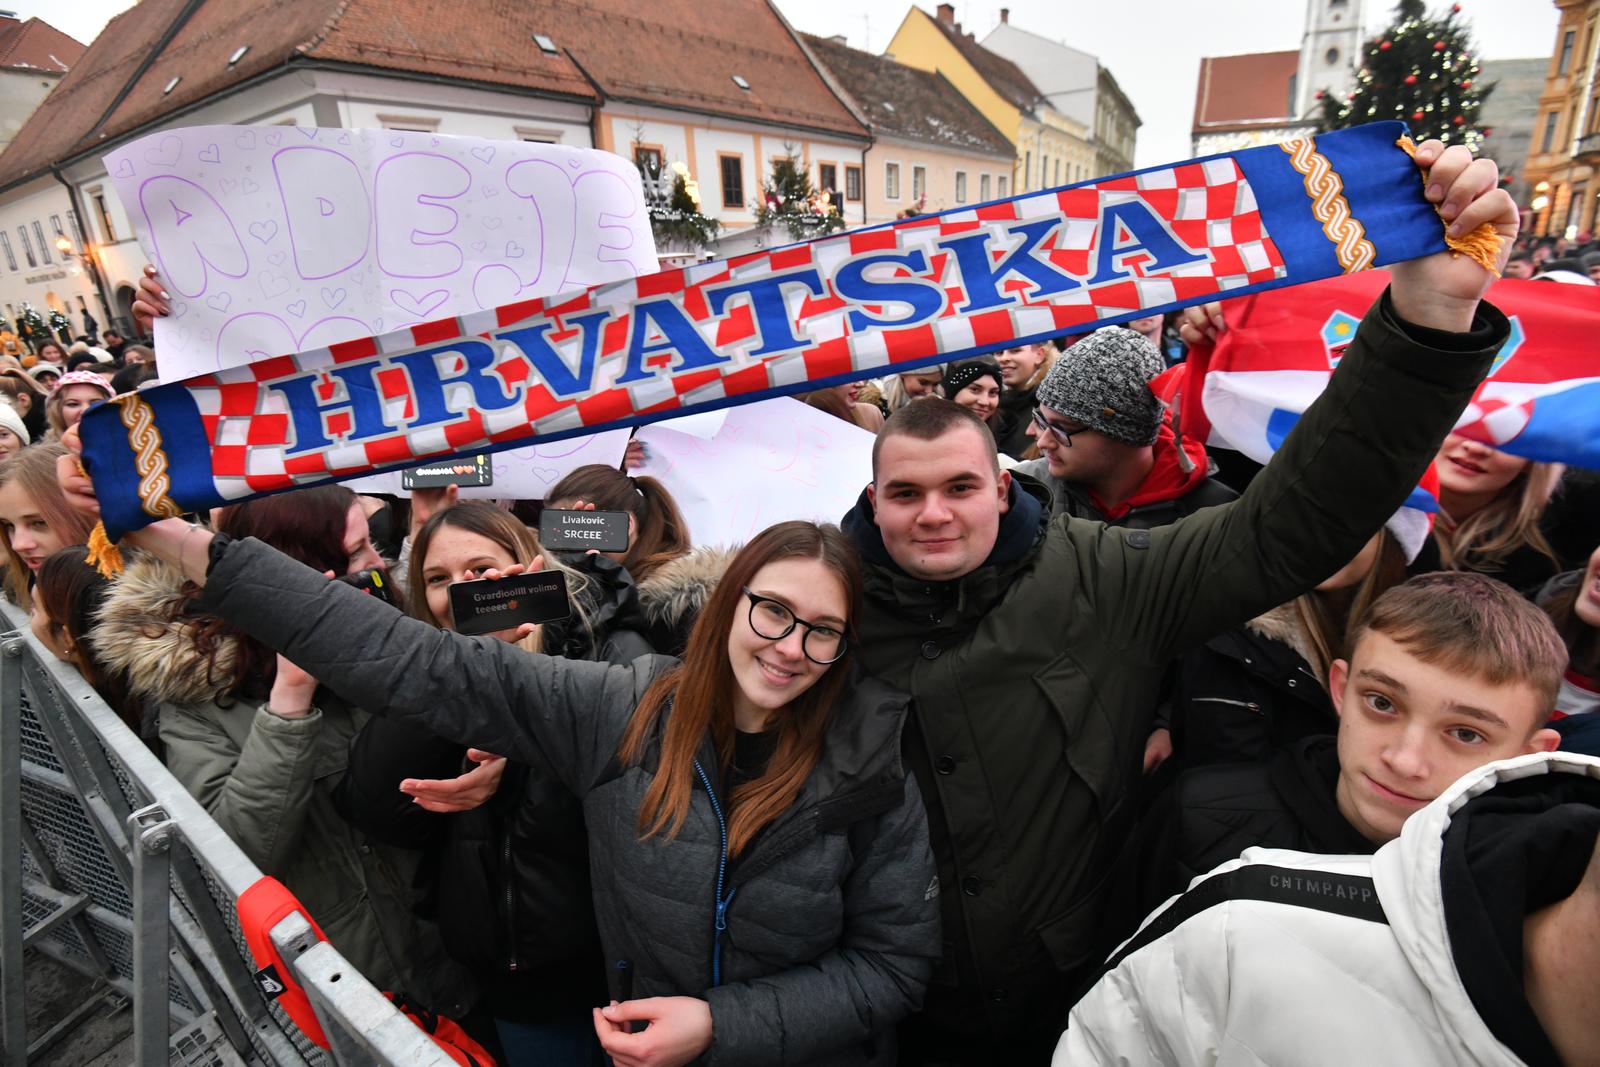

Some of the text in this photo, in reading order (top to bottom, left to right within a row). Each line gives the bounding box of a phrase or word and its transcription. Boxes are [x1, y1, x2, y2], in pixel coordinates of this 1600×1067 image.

[267, 198, 1212, 457] HRVATSKA
[562, 515, 605, 525] Livakovic
[564, 529, 602, 540] SRCEEE
[528, 583, 559, 595] volimo
[475, 604, 508, 615] teeeee
[1269, 874, 1380, 905] CNTMP.APP
